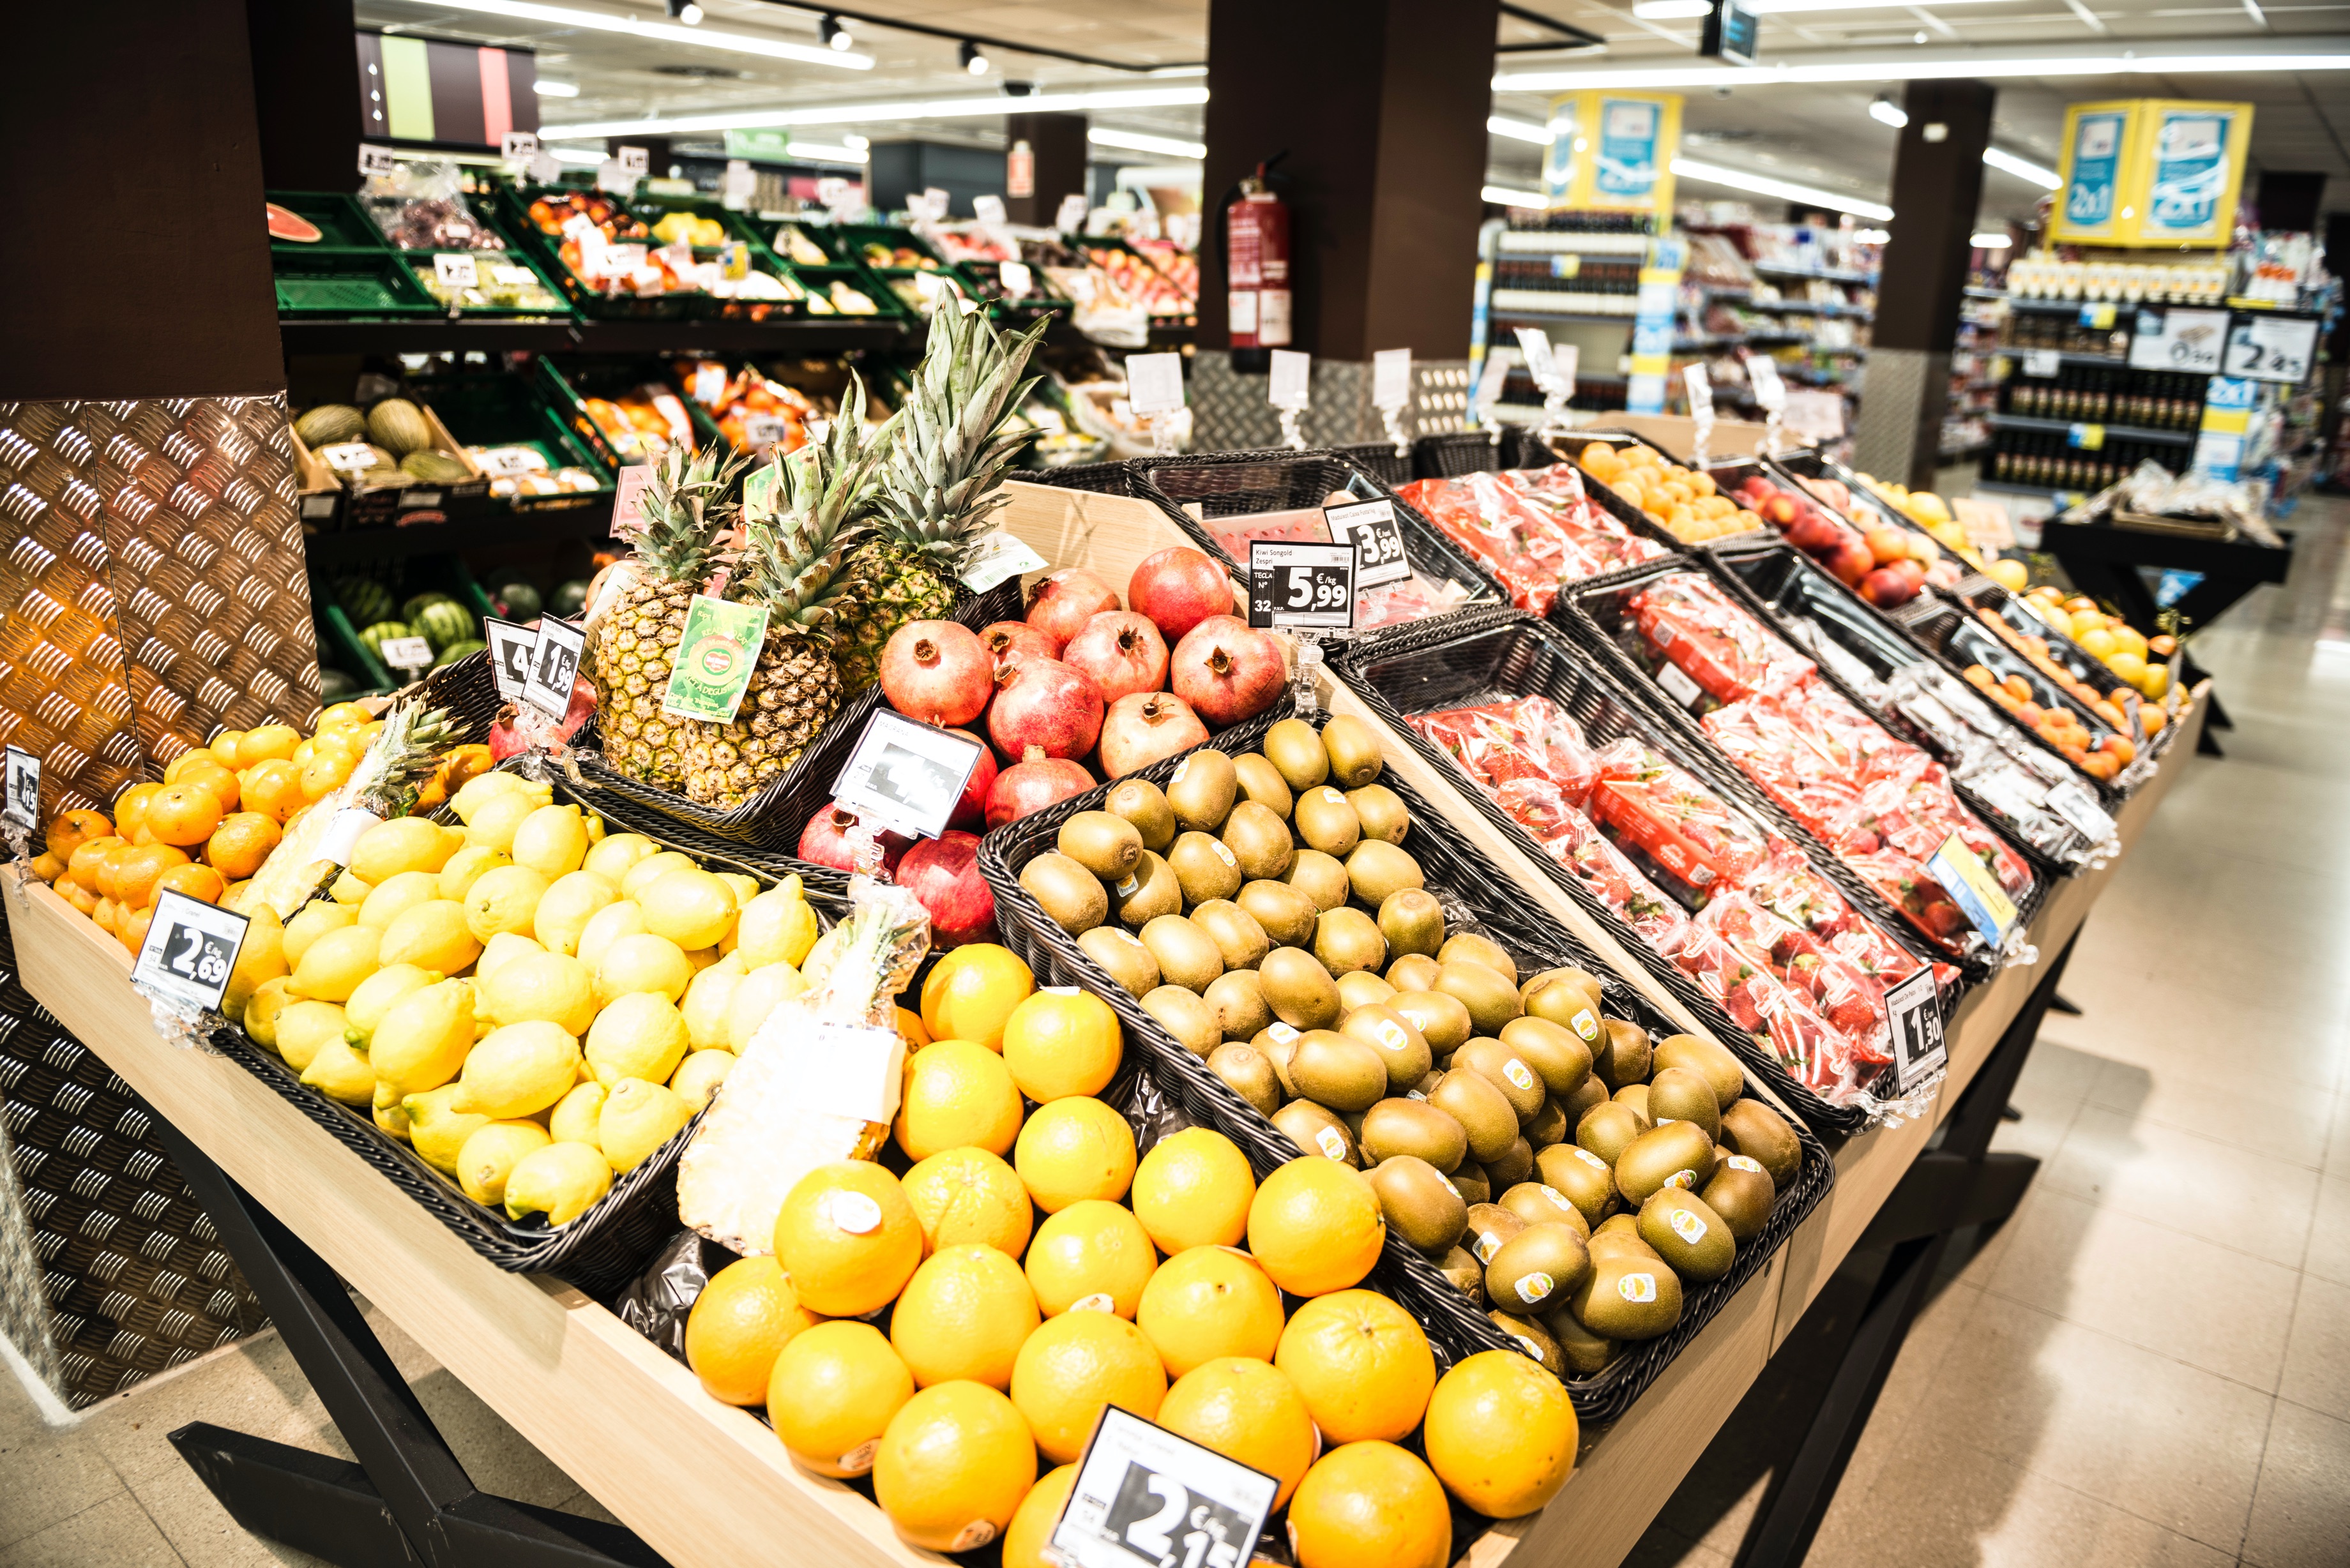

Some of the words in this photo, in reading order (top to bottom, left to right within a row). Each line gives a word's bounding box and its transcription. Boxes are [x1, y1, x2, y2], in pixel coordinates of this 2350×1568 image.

[1356, 524, 1400, 564] 3,99
[1254, 599, 1271, 612] 32
[1287, 567, 1347, 612] 5,99
[547, 644, 572, 692] 1,99
[172, 928, 227, 983] 2,69
[1890, 995, 1904, 1007] Maduixot
[1911, 1006, 1941, 1053] 1,30
[1126, 1473, 1240, 1568] 2,15
